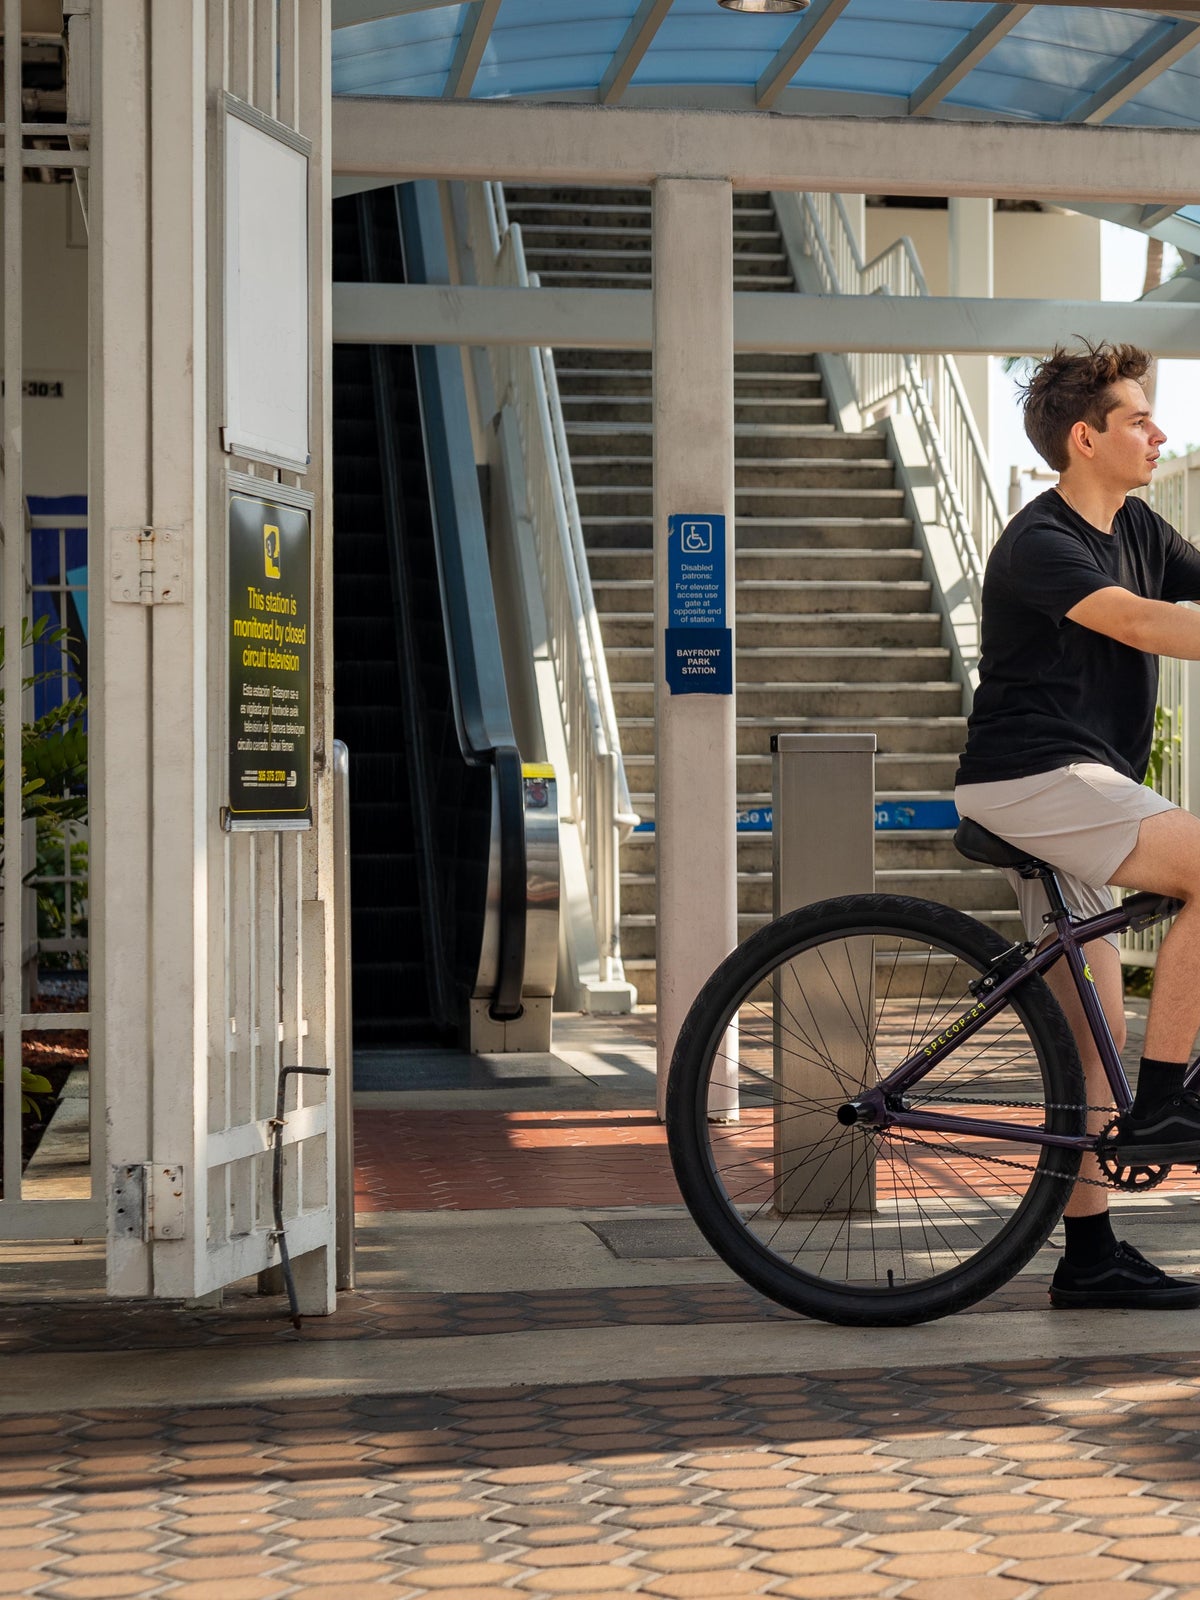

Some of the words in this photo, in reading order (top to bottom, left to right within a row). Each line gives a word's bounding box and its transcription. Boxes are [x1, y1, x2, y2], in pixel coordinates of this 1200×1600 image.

[248, 587, 265, 611] This
[265, 591, 290, 614] station
[290, 594, 297, 616] is
[685, 600, 702, 608] gate
[673, 608, 706, 616] opposite
[233, 616, 274, 641] monitored
[274, 620, 284, 647] by
[285, 621, 307, 645] closed
[242, 644, 267, 668] circuit
[267, 648, 300, 672] television
[677, 649, 721, 657] BAYFRONT
[681, 667, 716, 675] STATION
[924, 1002, 986, 1056] SPECOP-29
